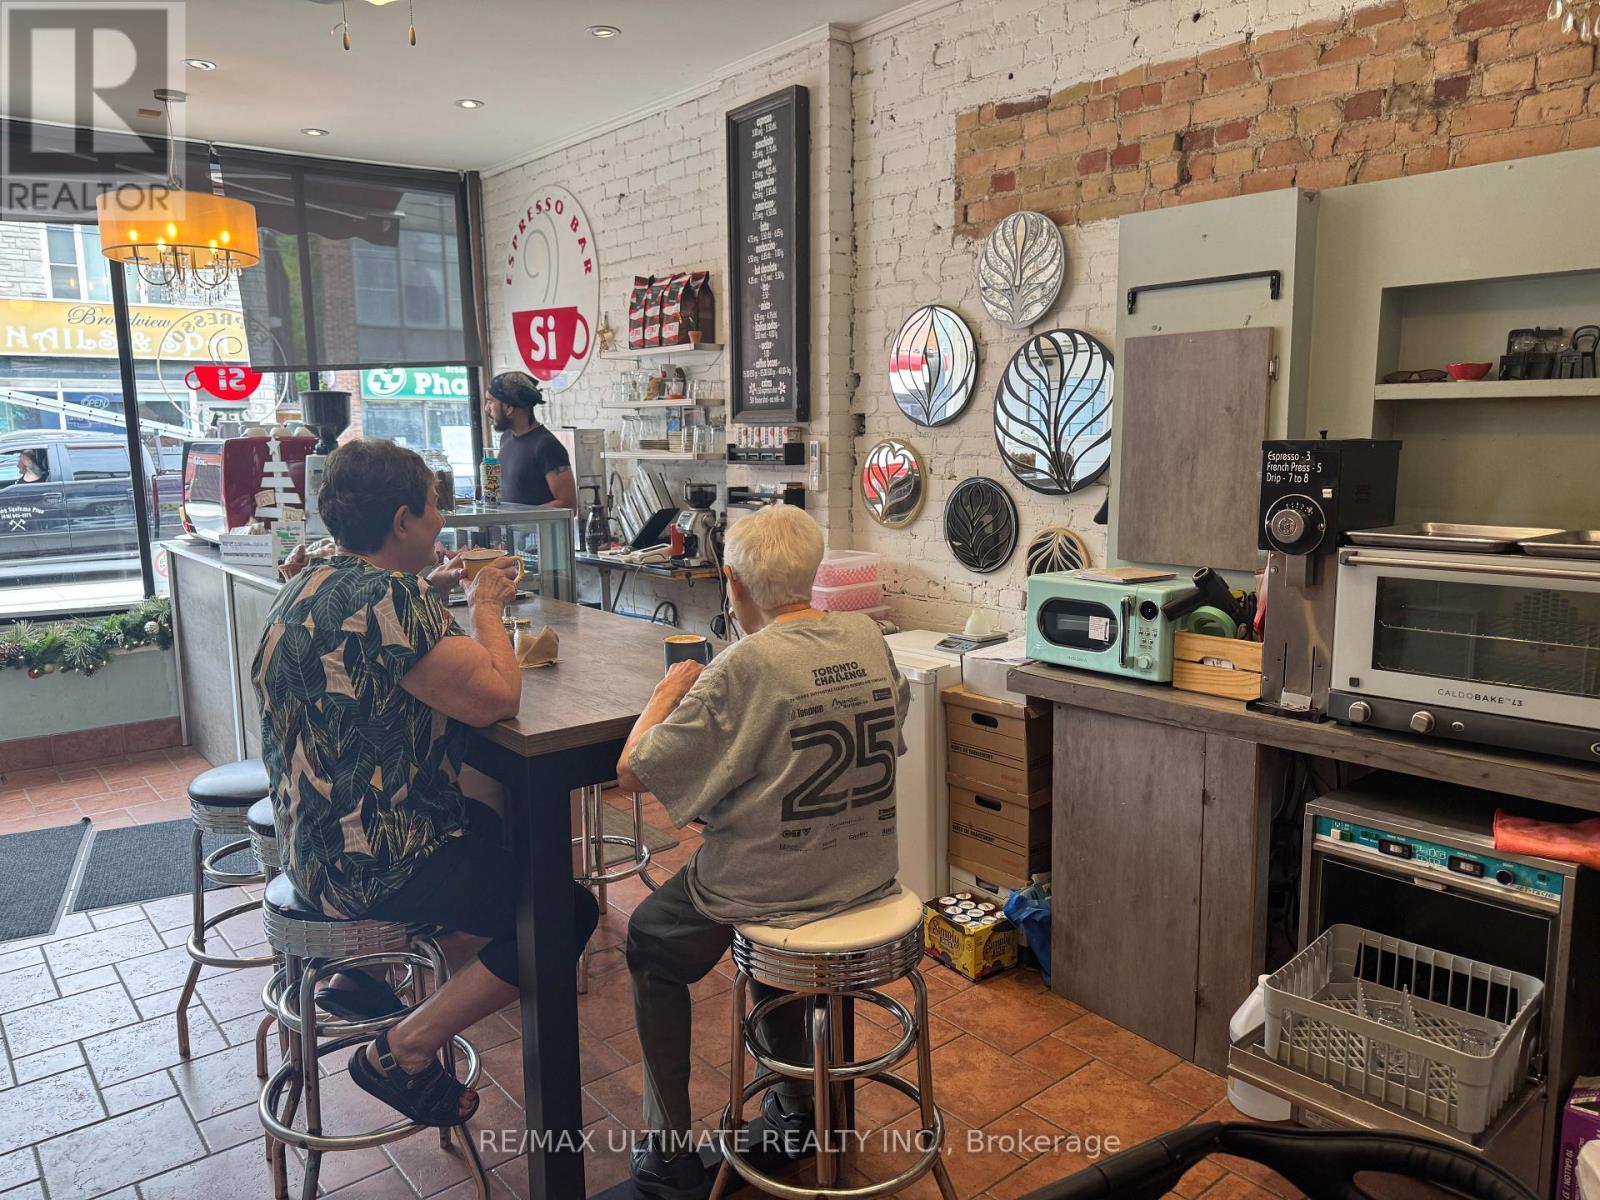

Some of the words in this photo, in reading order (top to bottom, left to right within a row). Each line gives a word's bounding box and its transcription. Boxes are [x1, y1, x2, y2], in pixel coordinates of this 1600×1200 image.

[506, 197, 564, 286] ESPRESSO
[570, 216, 592, 276] BAR
[67, 305, 171, 328] Brodview
[530, 314, 558, 362] Si
[82, 397, 109, 409] OPEN
[1267, 451, 1299, 462] Espresso
[1306, 451, 1311, 460] 3
[1266, 462, 1289, 472] French
[1291, 462, 1310, 472] Press
[1317, 463, 1322, 473] 5
[1266, 473, 1281, 484] Drip
[1288, 473, 1293, 482] 7
[1294, 475, 1302, 483] to
[1304, 473, 1309, 483] 8
[811, 661, 859, 678] TORONTO
[814, 668, 867, 687] CHALLENGE
[781, 706, 896, 821] 25
